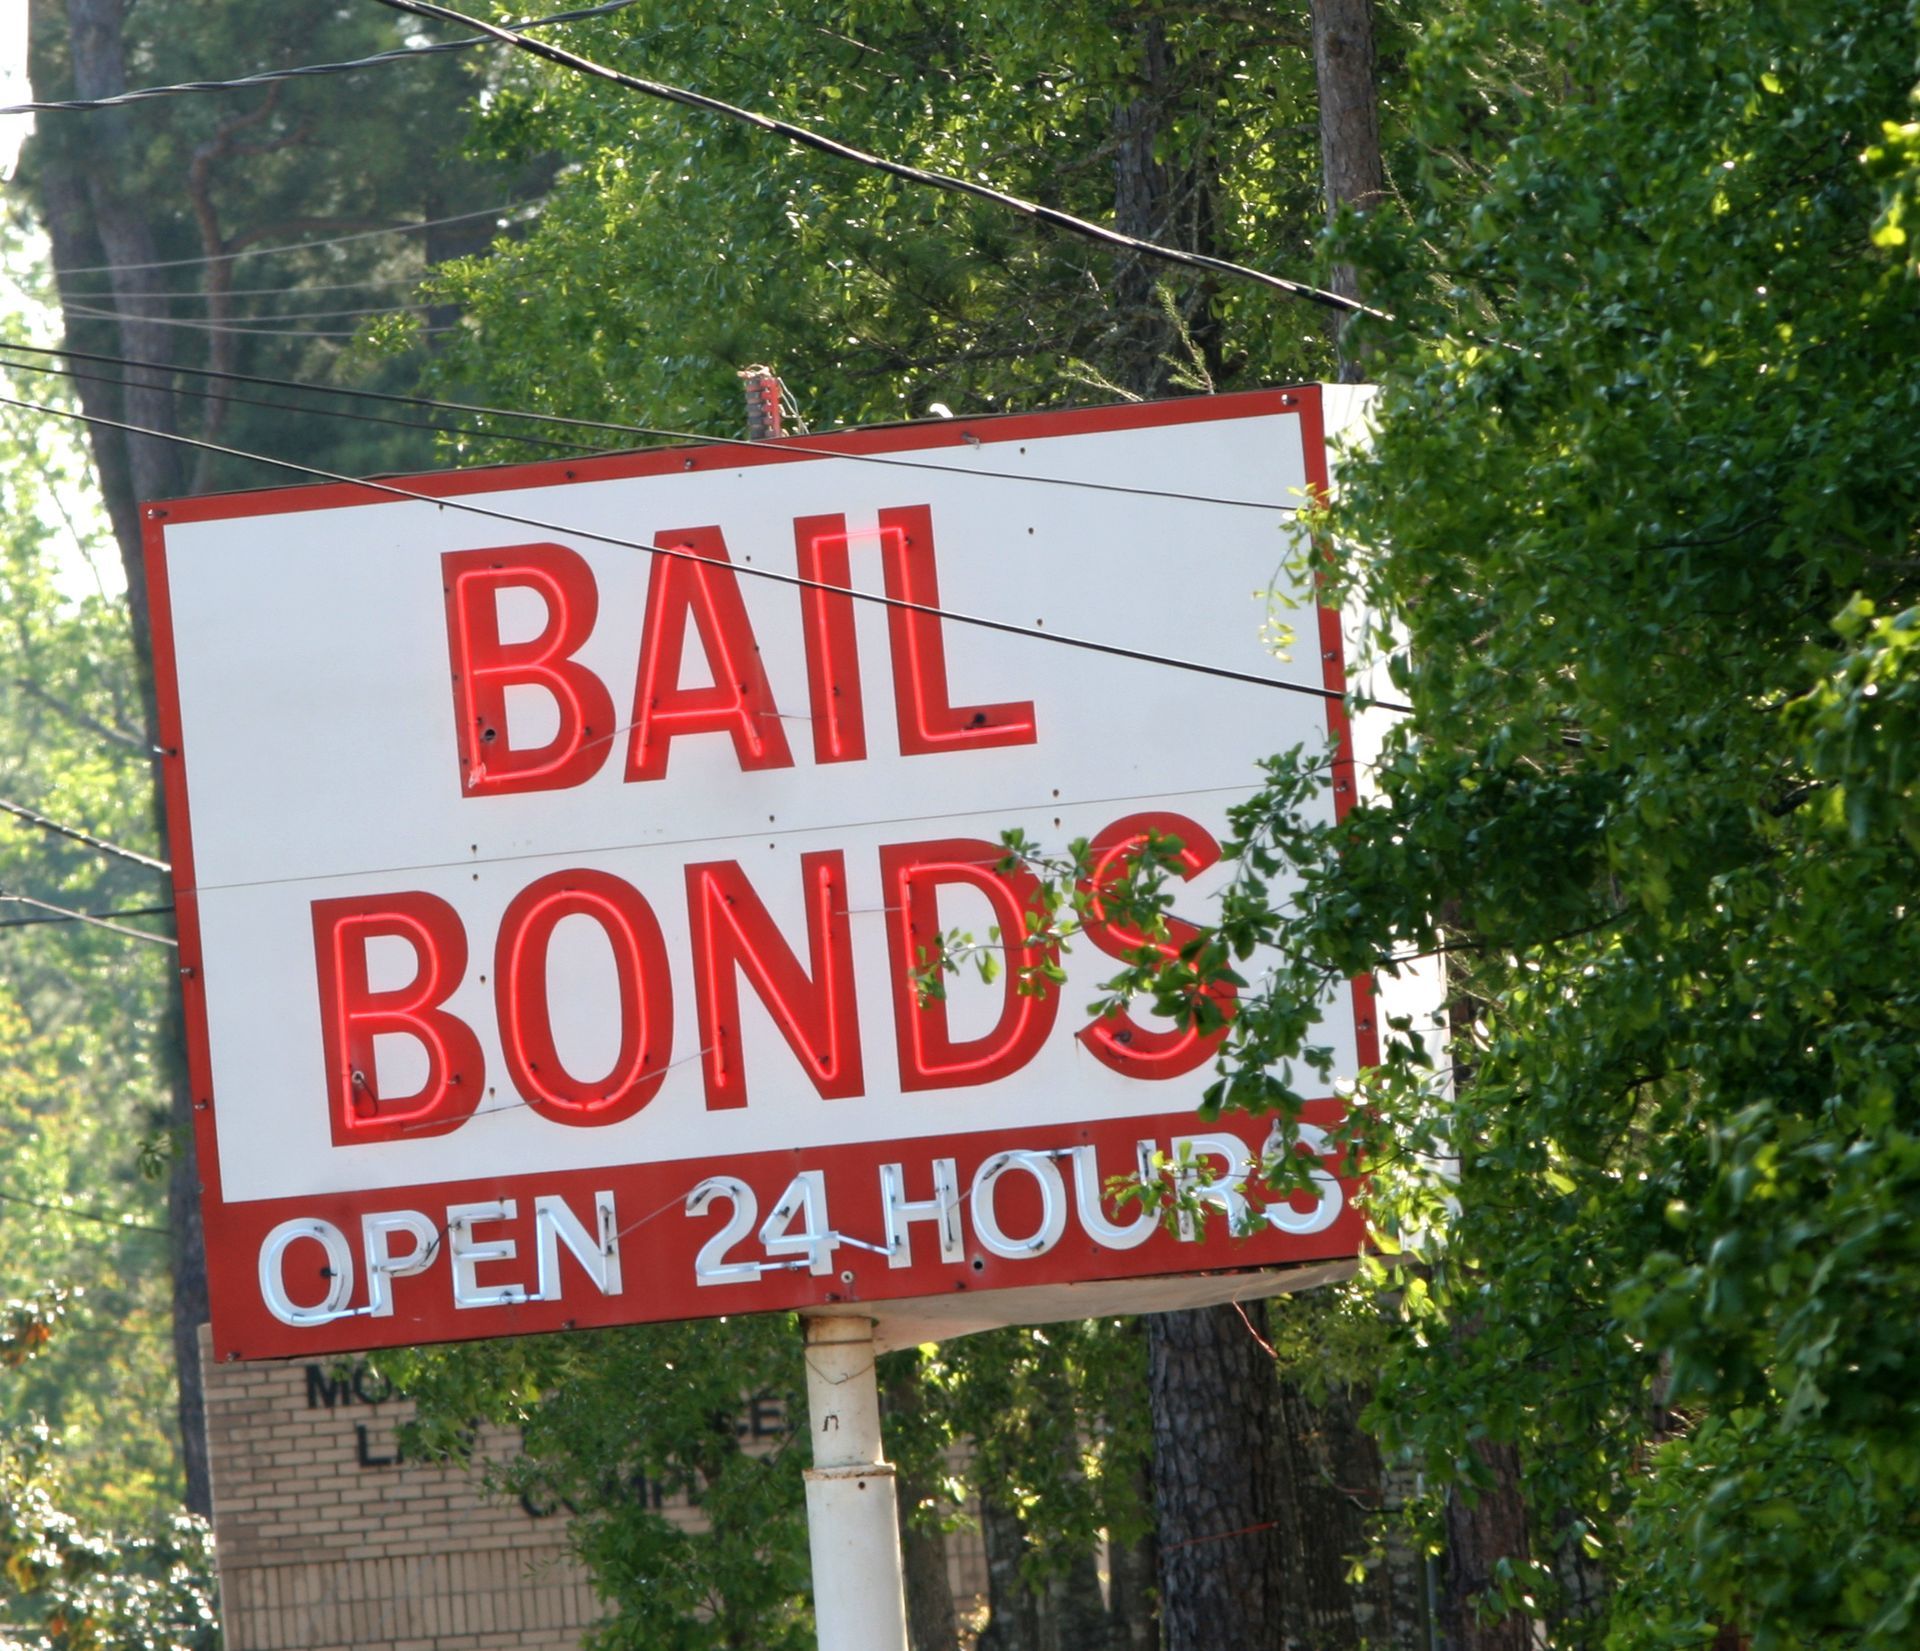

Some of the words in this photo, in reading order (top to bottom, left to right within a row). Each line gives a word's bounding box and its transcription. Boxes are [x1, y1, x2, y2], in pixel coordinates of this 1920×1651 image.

[441, 504, 1037, 797] BAIL
[310, 811, 1239, 1146] BONDS
[258, 1190, 623, 1327] OPEN
[685, 1170, 840, 1286] 24
[879, 1123, 1343, 1269] HOURS
